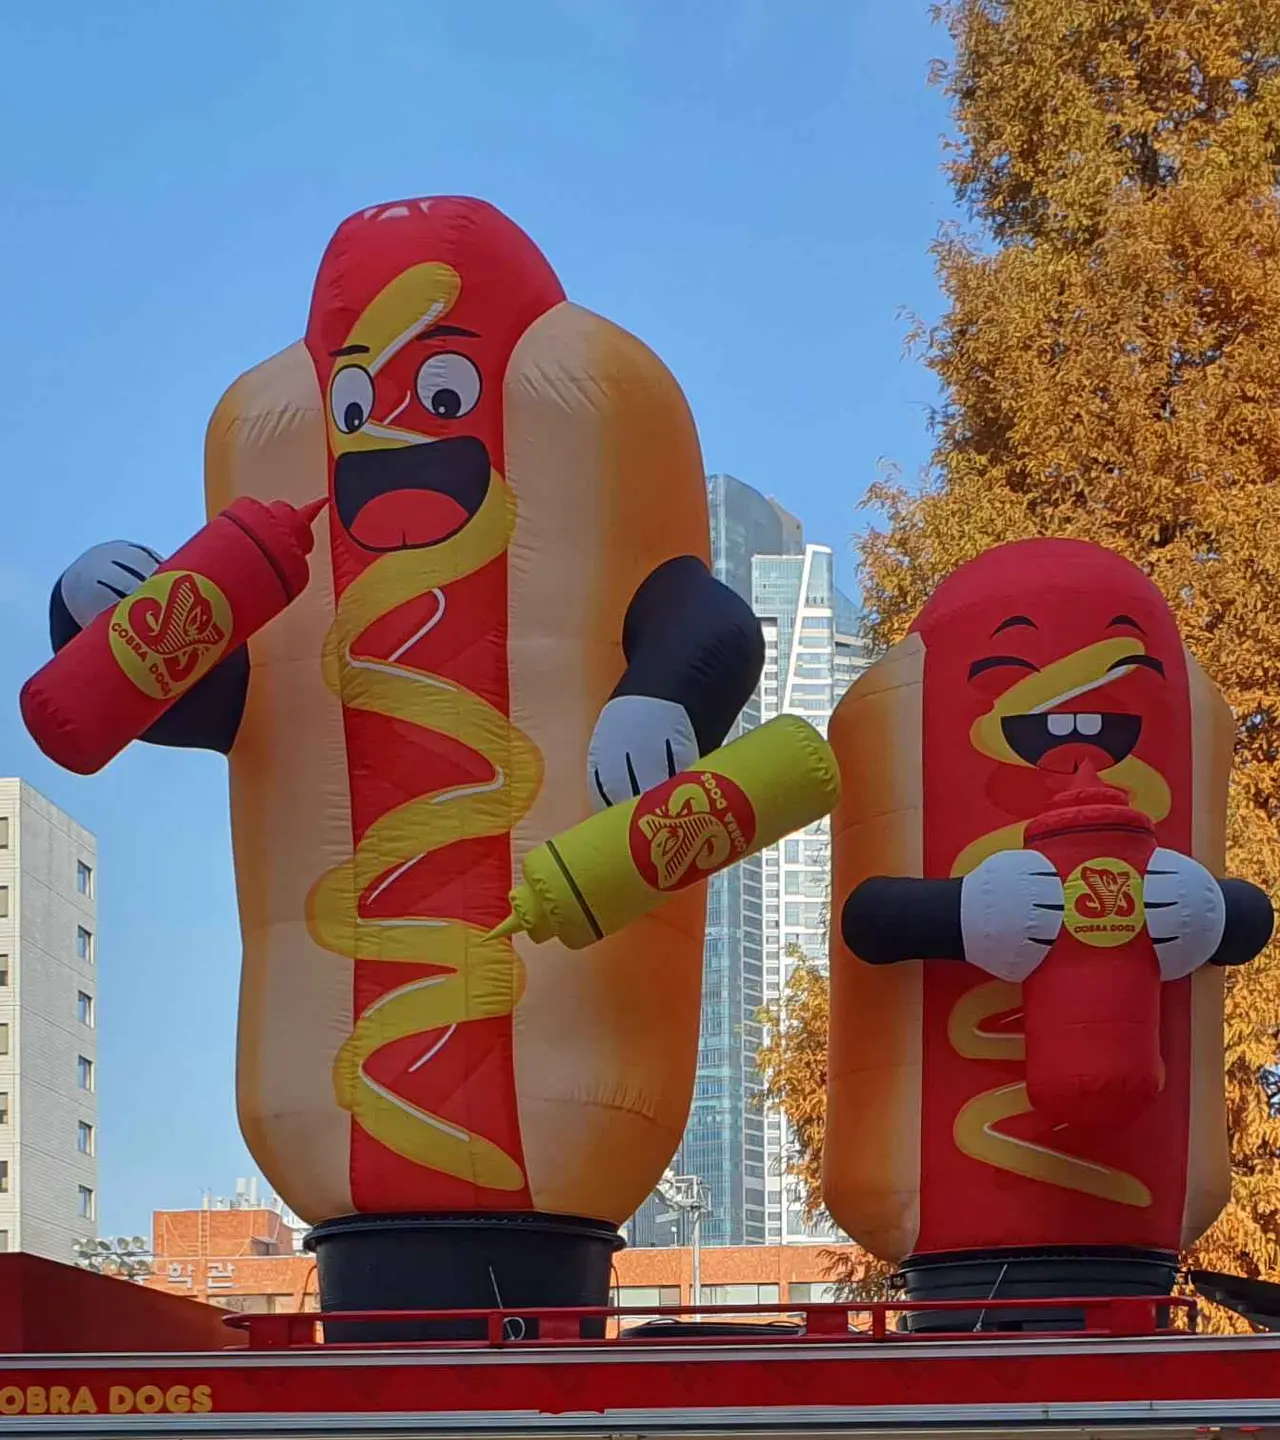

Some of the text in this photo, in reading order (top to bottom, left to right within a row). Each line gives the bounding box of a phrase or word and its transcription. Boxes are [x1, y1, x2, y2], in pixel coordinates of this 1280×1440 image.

[111, 622, 149, 662] COBRA
[701, 772, 747, 852] COBRA DOGS
[1074, 923, 1136, 933] COBRA DOGS
[109, 1385, 212, 1414] DOGS
